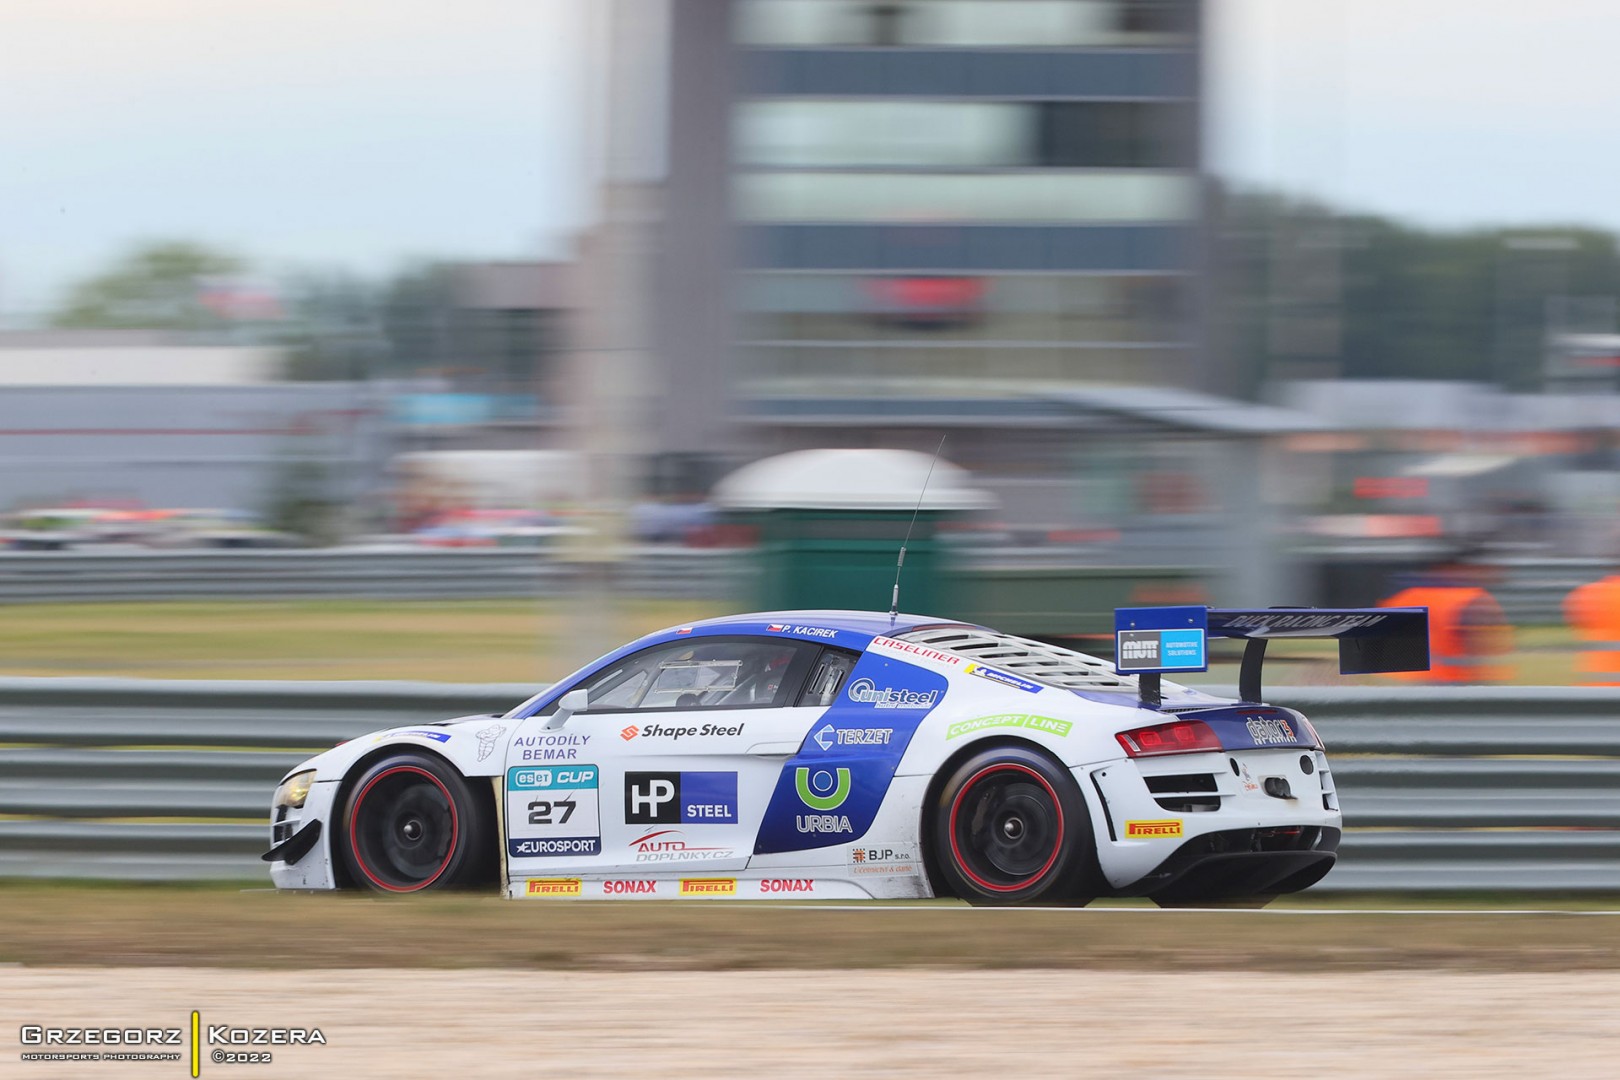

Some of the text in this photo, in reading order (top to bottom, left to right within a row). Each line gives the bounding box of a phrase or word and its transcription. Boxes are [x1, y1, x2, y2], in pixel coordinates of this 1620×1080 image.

[782, 625, 838, 638] P. KACIREK
[873, 637, 960, 664] CASELINER
[642, 723, 745, 740] Shape Steel
[950, 715, 1069, 735] CONCEPT LINE
[514, 733, 591, 747] AUTODÍLY
[836, 728, 893, 744] TERZET
[522, 749, 577, 760] BEMAR
[557, 771, 594, 783] CUP
[632, 779, 675, 817] HP
[528, 801, 576, 824] 27
[687, 804, 732, 817] STEEL
[796, 815, 853, 833] URBIA
[1129, 821, 1181, 835] PIRELLI
[523, 840, 596, 853] EUROSPORT
[638, 841, 686, 852] AUTO
[868, 850, 893, 860] BJP
[529, 880, 580, 893] PIRELLI
[603, 880, 657, 894] SONAX
[682, 879, 734, 892] PIRELLI
[760, 879, 814, 892] SONAX
